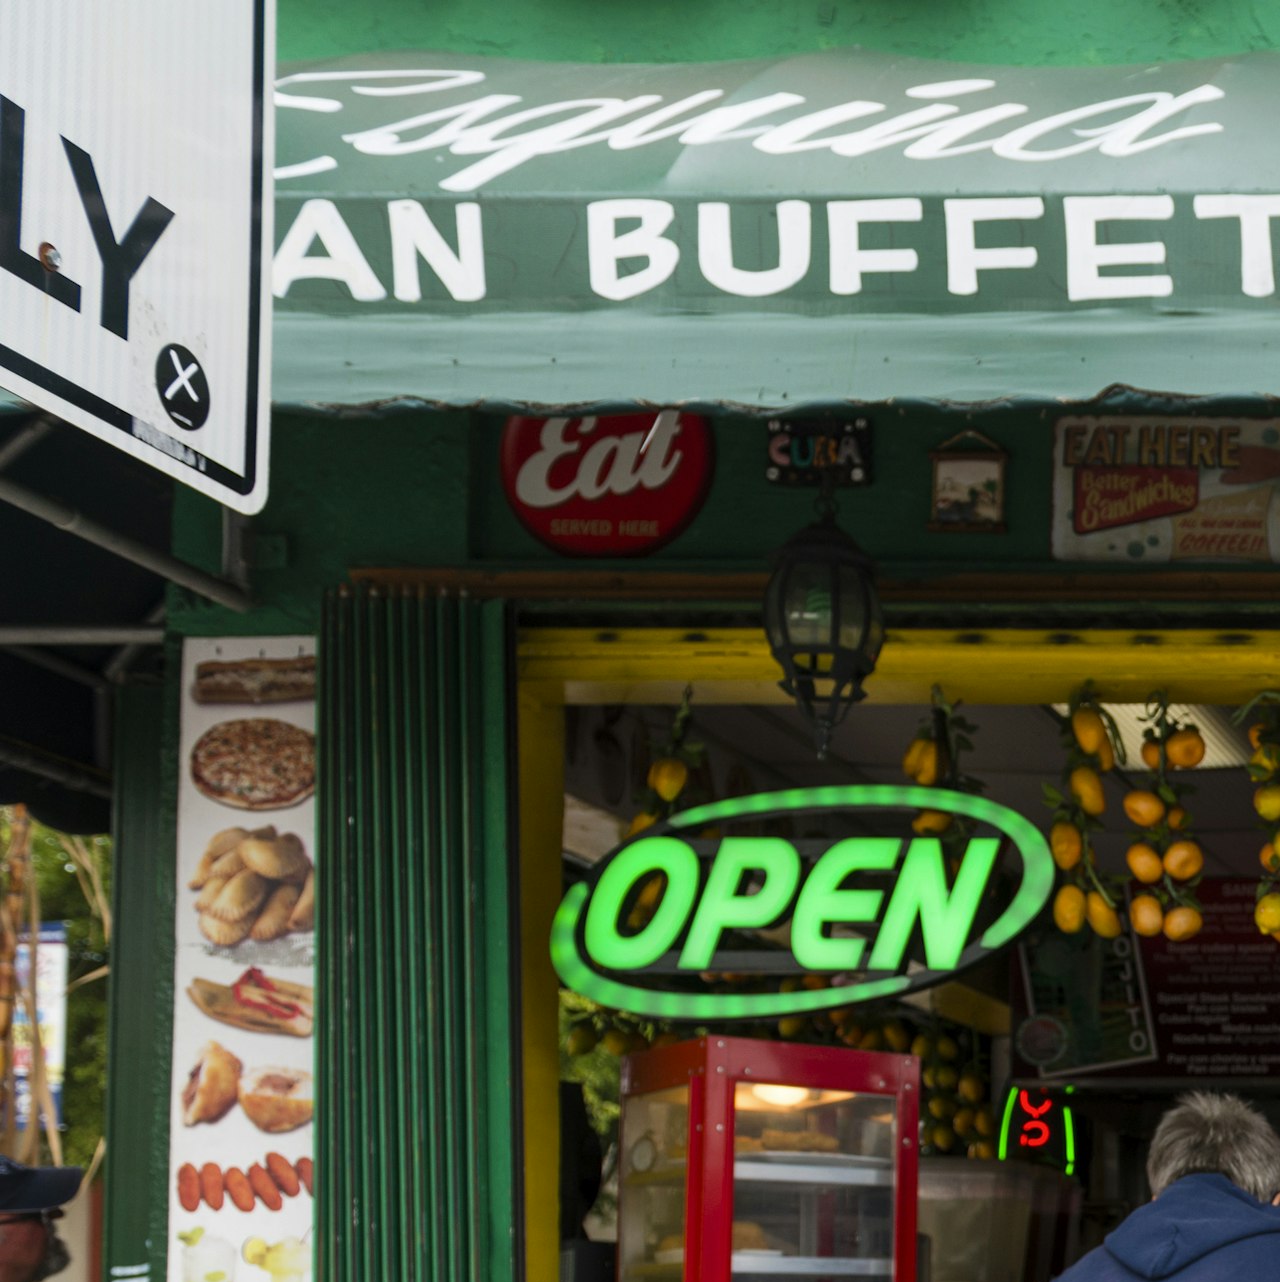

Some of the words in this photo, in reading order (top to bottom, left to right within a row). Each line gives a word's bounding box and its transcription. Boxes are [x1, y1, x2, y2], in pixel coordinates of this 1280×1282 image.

[515, 409, 684, 508] Eat
[1064, 424, 1130, 467] EAT
[1138, 424, 1241, 469] HERE
[1081, 470, 1140, 492] Better
[1081, 473, 1196, 530] Sandwiches
[550, 518, 613, 537] SERVED
[618, 518, 660, 537] HERE
[584, 836, 999, 971] OPEN
